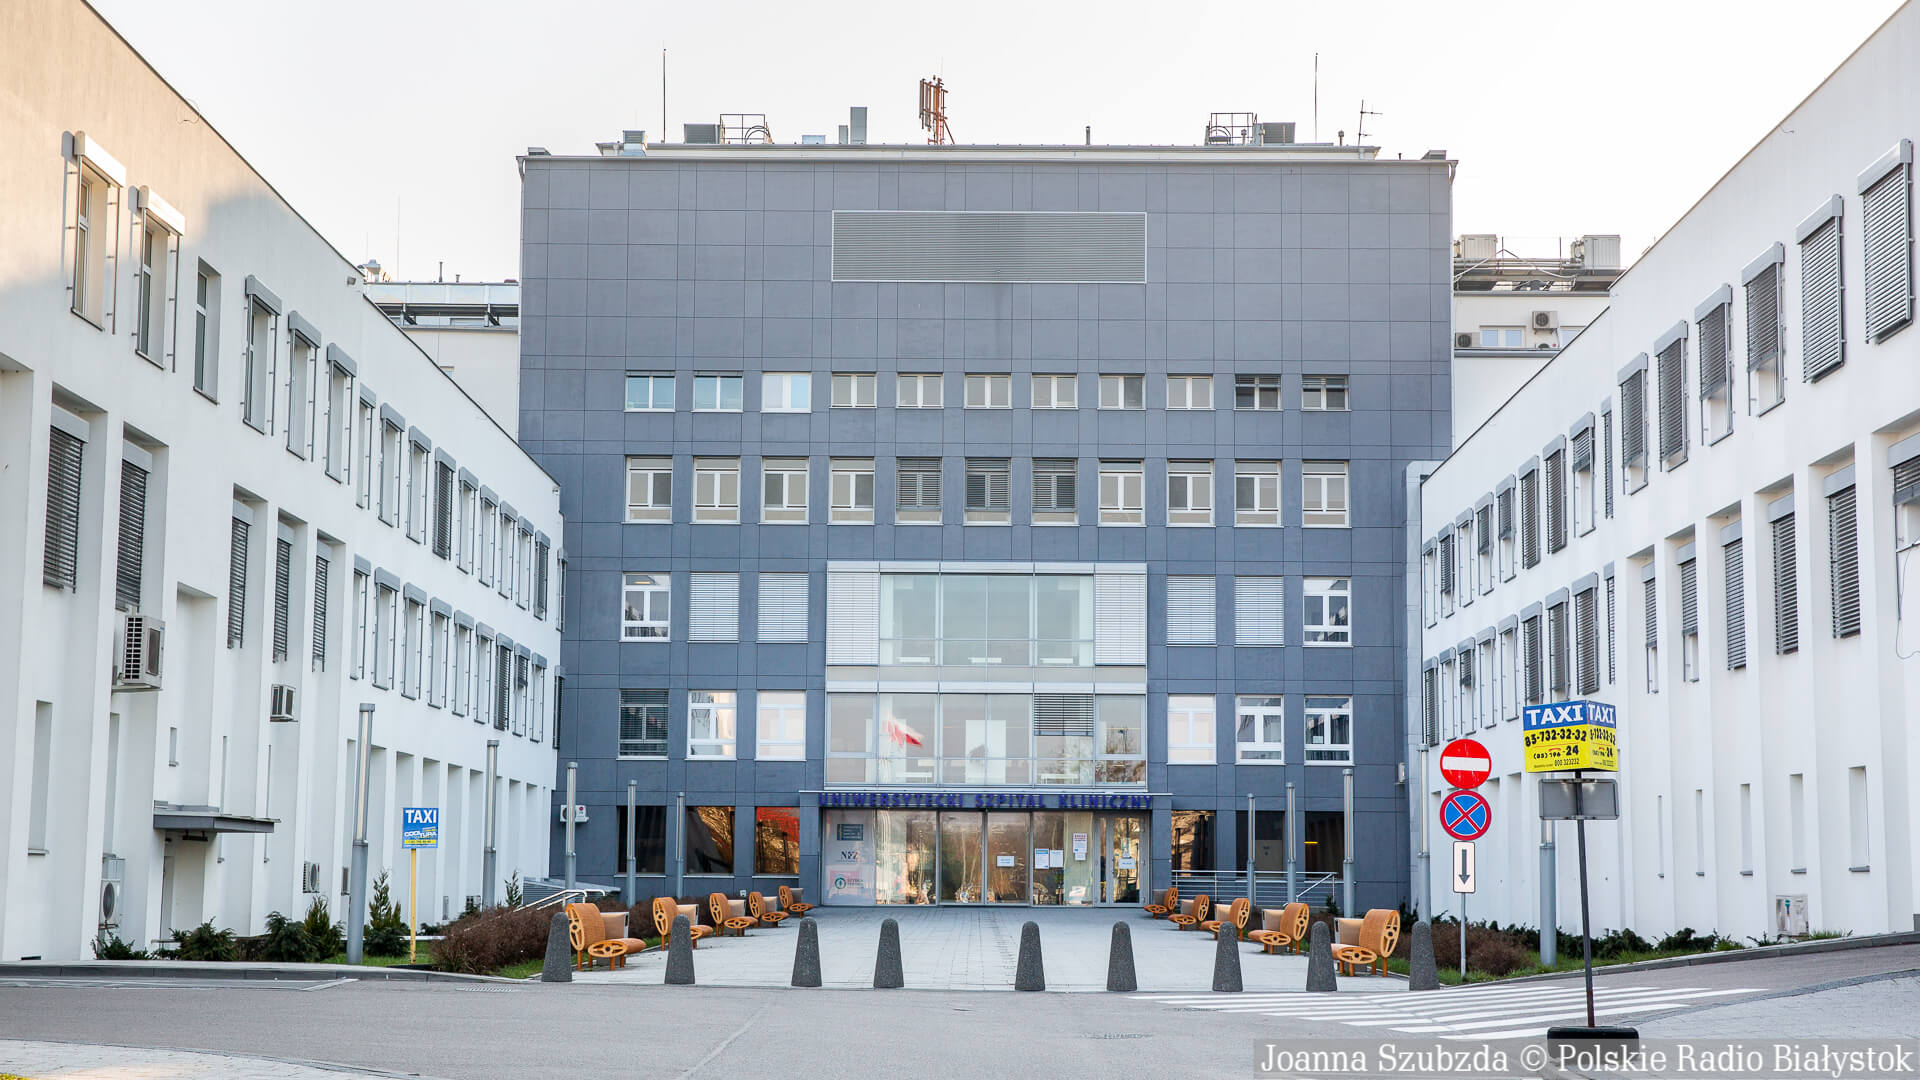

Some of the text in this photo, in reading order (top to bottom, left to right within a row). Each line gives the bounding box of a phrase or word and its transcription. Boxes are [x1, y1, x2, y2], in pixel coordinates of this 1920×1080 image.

[1526, 704, 1584, 726] TAXI
[1588, 704, 1615, 725] TAXI
[1524, 728, 1587, 747] 85-732-32-32
[819, 793, 1152, 808] UNIWERSYTECKI SZPITAL KLINICZNY
[405, 809, 437, 823] TAXI
